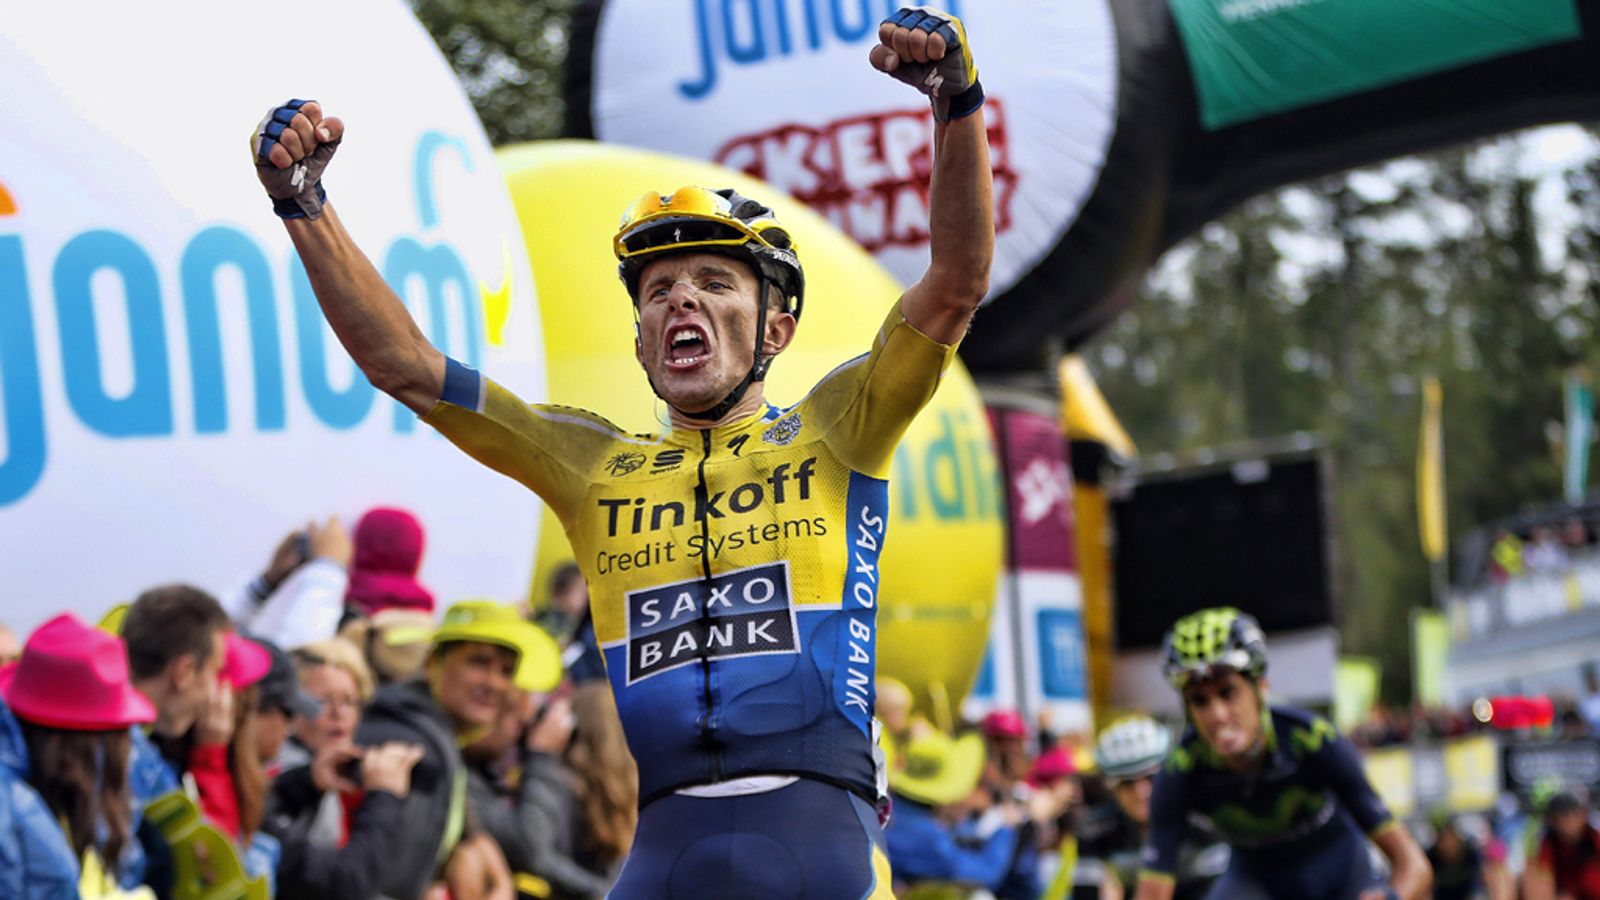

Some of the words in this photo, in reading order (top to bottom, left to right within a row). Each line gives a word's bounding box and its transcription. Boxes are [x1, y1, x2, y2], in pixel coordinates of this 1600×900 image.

[598, 456, 817, 538] Tinkoff
[597, 540, 676, 575] Credit
[687, 516, 827, 559] Systems
[854, 506, 883, 609] SAXO
[640, 577, 775, 628] SAXO
[639, 619, 779, 670] BANK
[844, 618, 871, 714] BANK
